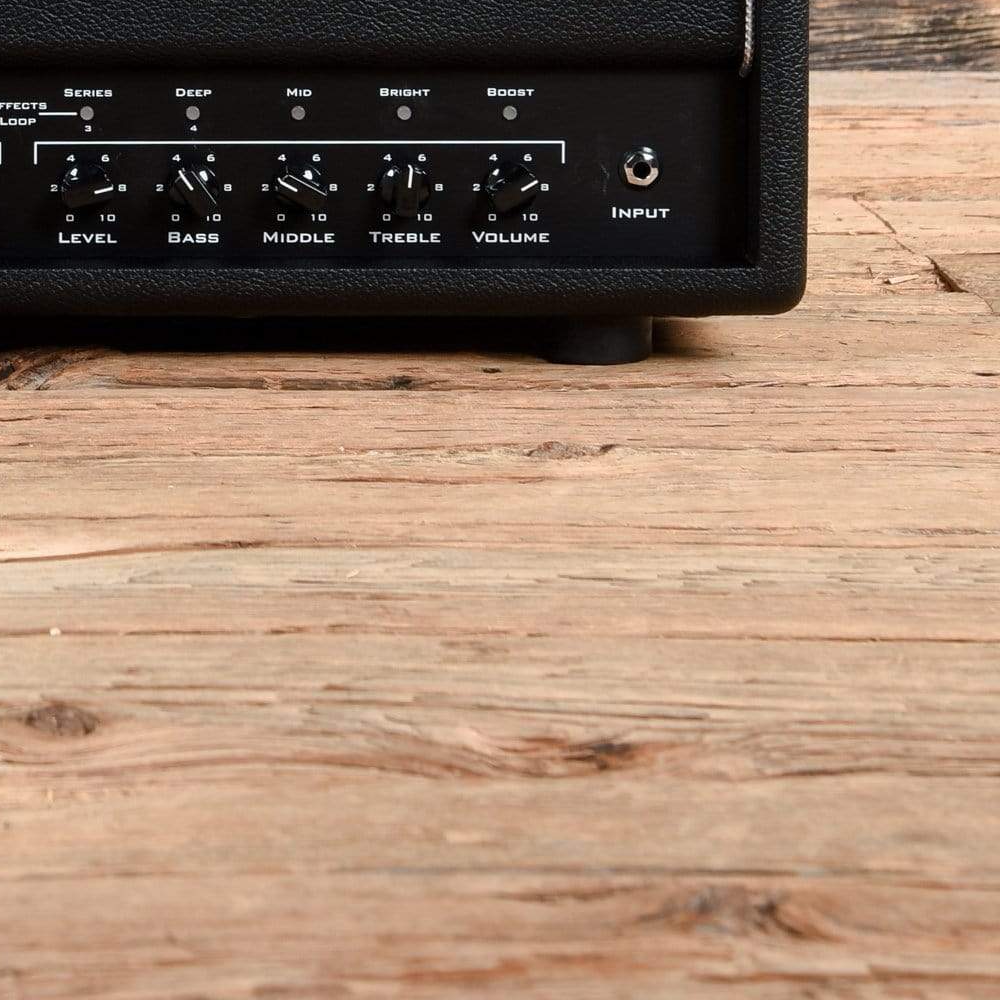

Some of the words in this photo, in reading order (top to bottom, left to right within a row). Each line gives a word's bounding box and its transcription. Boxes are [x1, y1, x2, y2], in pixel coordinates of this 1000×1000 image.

[63, 88, 113, 98] SERIES
[175, 88, 212, 98] DEEP
[286, 87, 313, 97] MID
[379, 87, 431, 97] BRIGHT
[486, 87, 535, 97] BOOST
[0, 116, 37, 126] LOOP
[66, 154, 76, 162] 4
[101, 154, 110, 163] 6
[171, 154, 181, 162] 4
[206, 153, 216, 162] 6
[277, 154, 287, 162] 4
[312, 153, 321, 162] 6
[383, 153, 393, 162] 4
[417, 153, 427, 162] 6
[488, 153, 498, 162] 4
[523, 153, 533, 162] 6
[50, 184, 59, 192] 2
[118, 183, 127, 192] 8
[155, 183, 164, 192] 2
[223, 183, 233, 192] 8
[261, 183, 270, 192] 2
[329, 183, 338, 192] 8
[366, 183, 375, 192] 2
[434, 183, 444, 192] 8
[472, 183, 481, 192] 2
[540, 183, 550, 192] 8
[611, 206, 671, 219] INPUT
[99, 213, 116, 222] 10
[206, 213, 222, 222] 10
[311, 213, 327, 222] 10
[417, 213, 433, 222] 10
[522, 213, 539, 222] 10
[58, 231, 118, 244] LEVEL
[167, 231, 220, 244] BASS
[263, 231, 335, 244] MIDDLE
[368, 231, 441, 244] TREBLE
[471, 230, 550, 243] VOLUME
